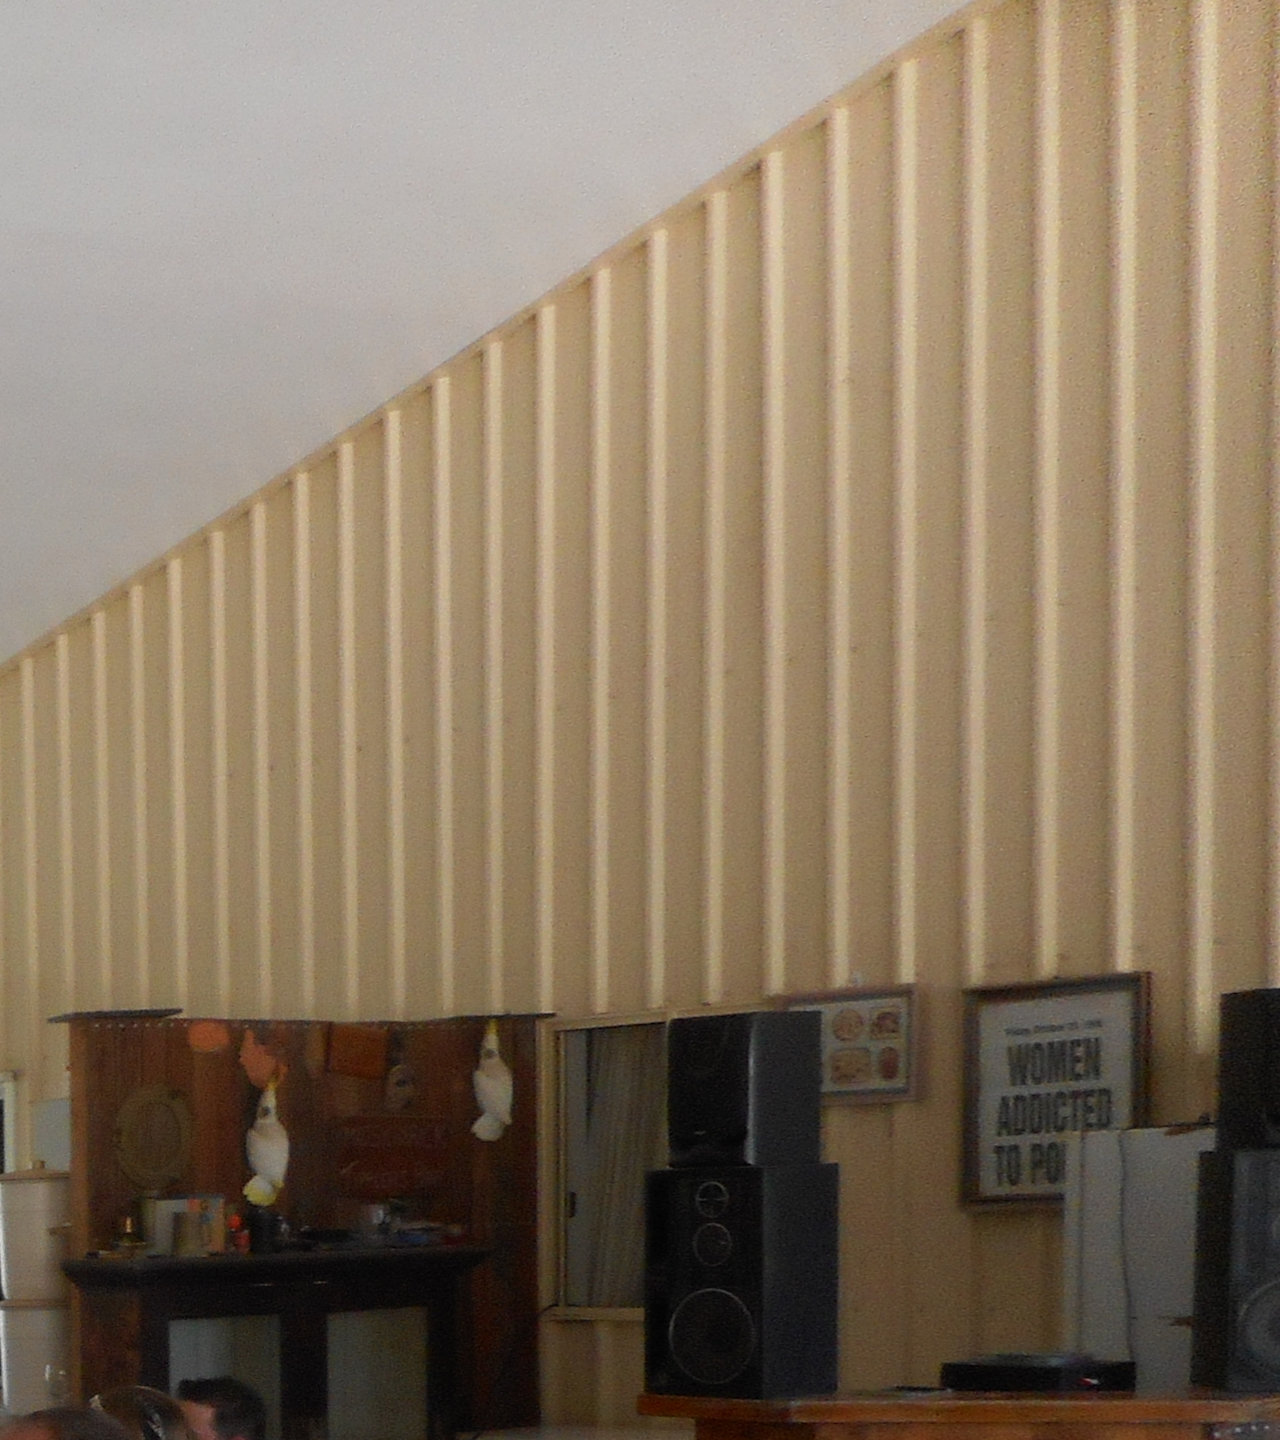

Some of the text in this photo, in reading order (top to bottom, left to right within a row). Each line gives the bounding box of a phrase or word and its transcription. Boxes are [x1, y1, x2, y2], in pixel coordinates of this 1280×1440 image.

[1007, 1037, 1102, 1086] WOMEN
[997, 1087, 1112, 1137] ADDICTED
[994, 1142, 1066, 1186] TO PO
